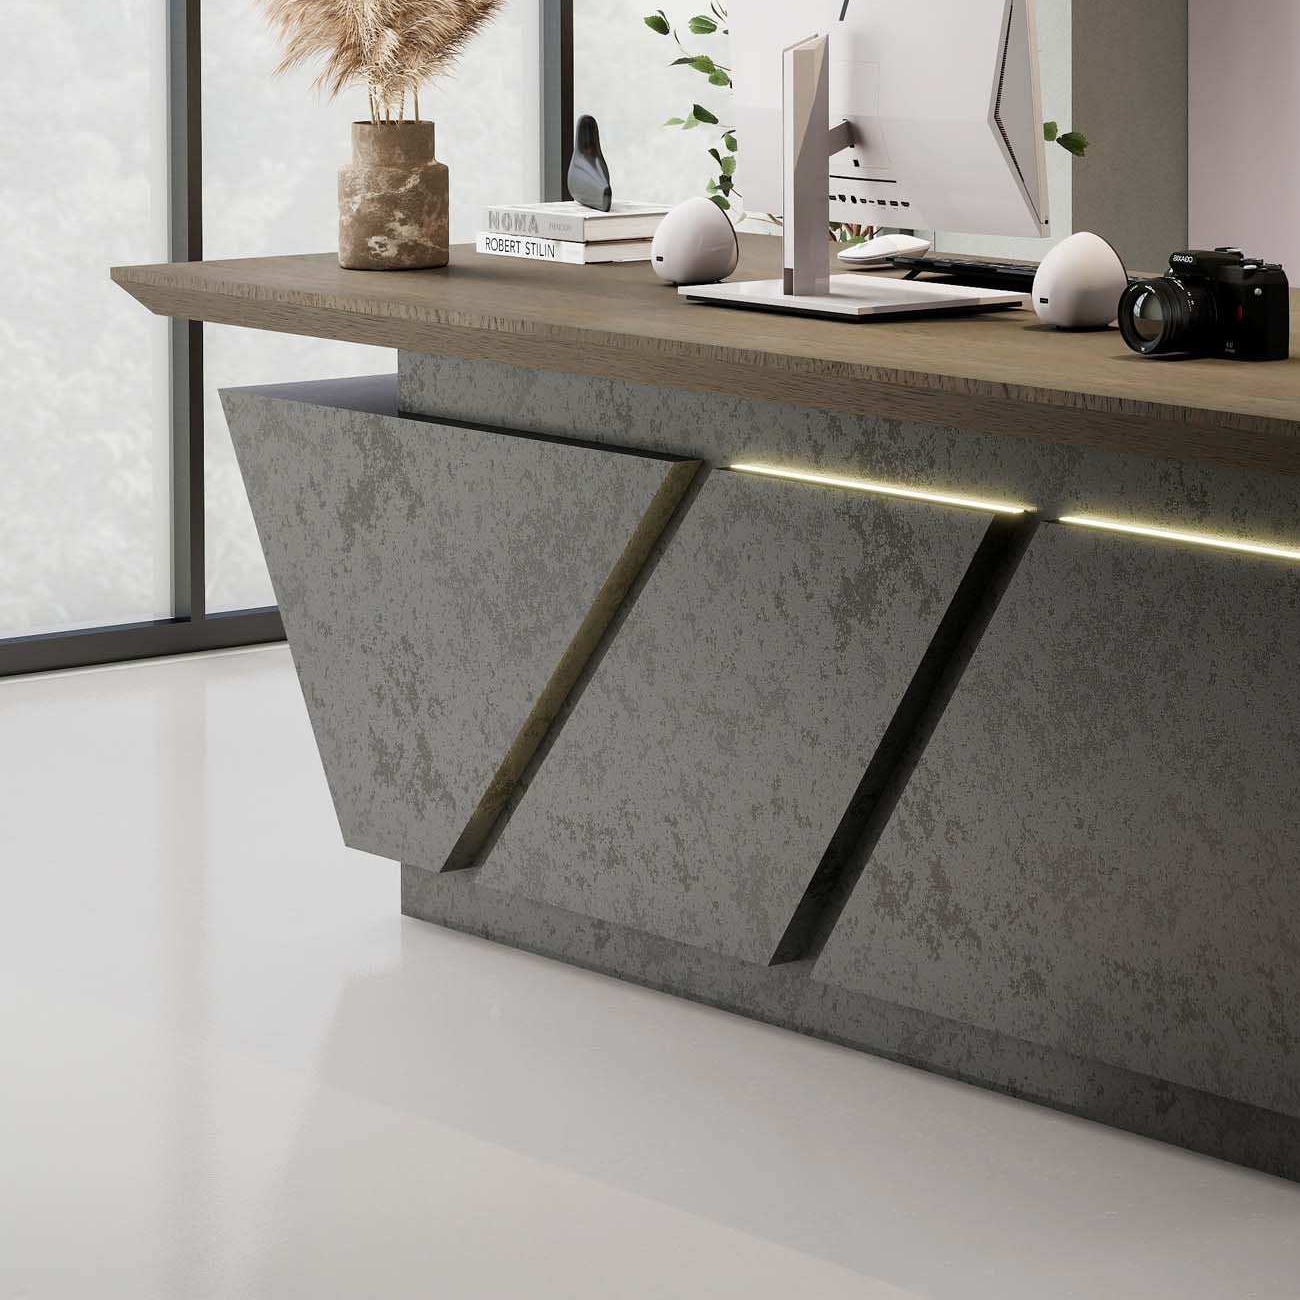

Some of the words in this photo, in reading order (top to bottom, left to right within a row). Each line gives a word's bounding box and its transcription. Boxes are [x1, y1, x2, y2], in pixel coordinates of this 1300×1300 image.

[488, 210, 539, 234] NOMA
[485, 237, 521, 254] ROBERT
[525, 241, 555, 258] STILIN
